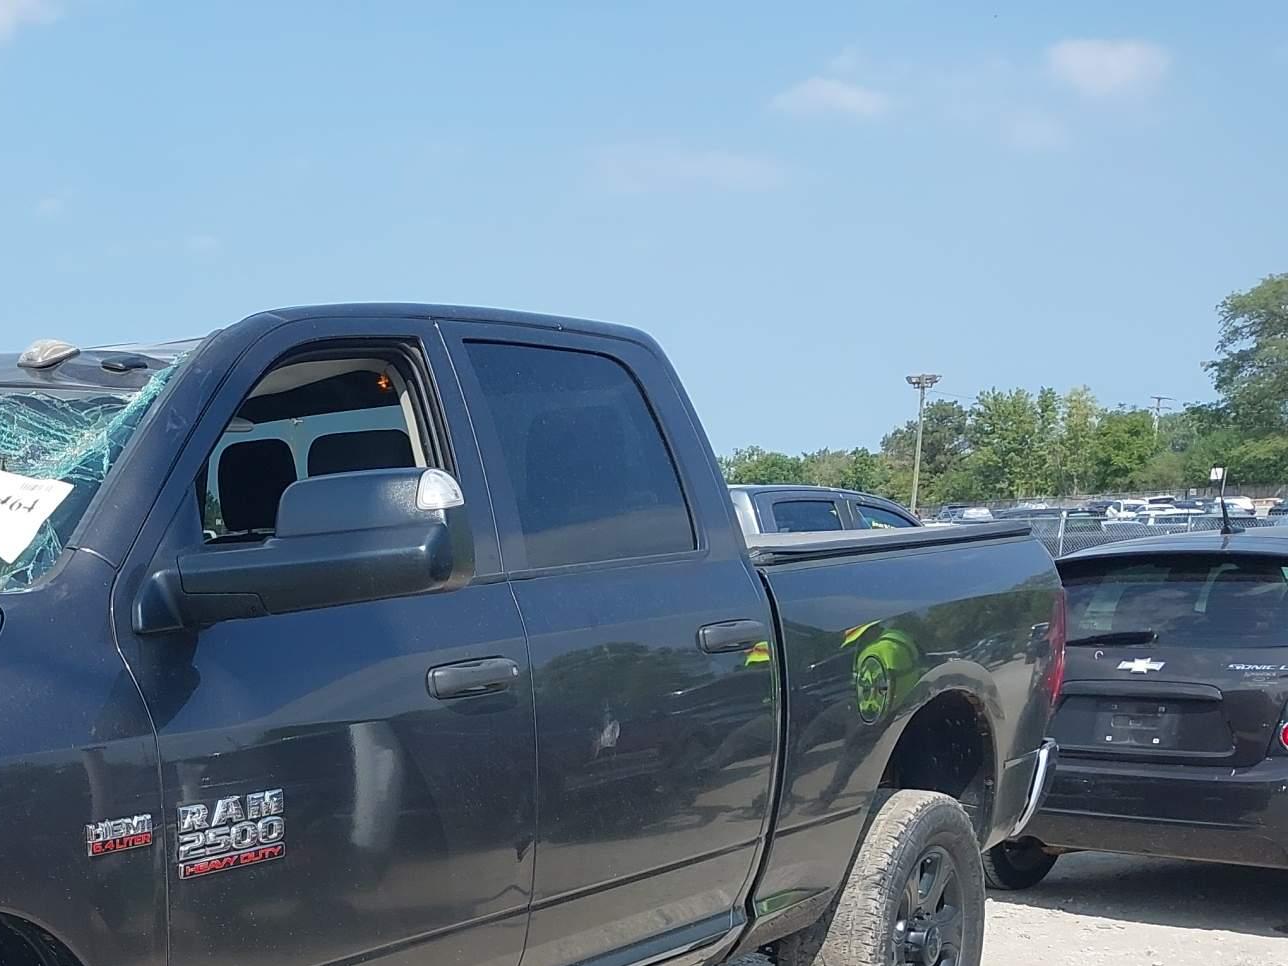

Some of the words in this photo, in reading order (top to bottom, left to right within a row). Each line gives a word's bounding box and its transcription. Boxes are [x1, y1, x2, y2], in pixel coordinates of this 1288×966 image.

[1226, 663, 1278, 671] SONIC
[179, 788, 284, 832] RAM
[86, 814, 152, 842] HEMI
[179, 816, 285, 860] 2500
[92, 840, 114, 854] 6.4
[115, 833, 151, 850] LITER
[184, 854, 238, 876] HEAVY
[240, 845, 282, 864] DUTY
